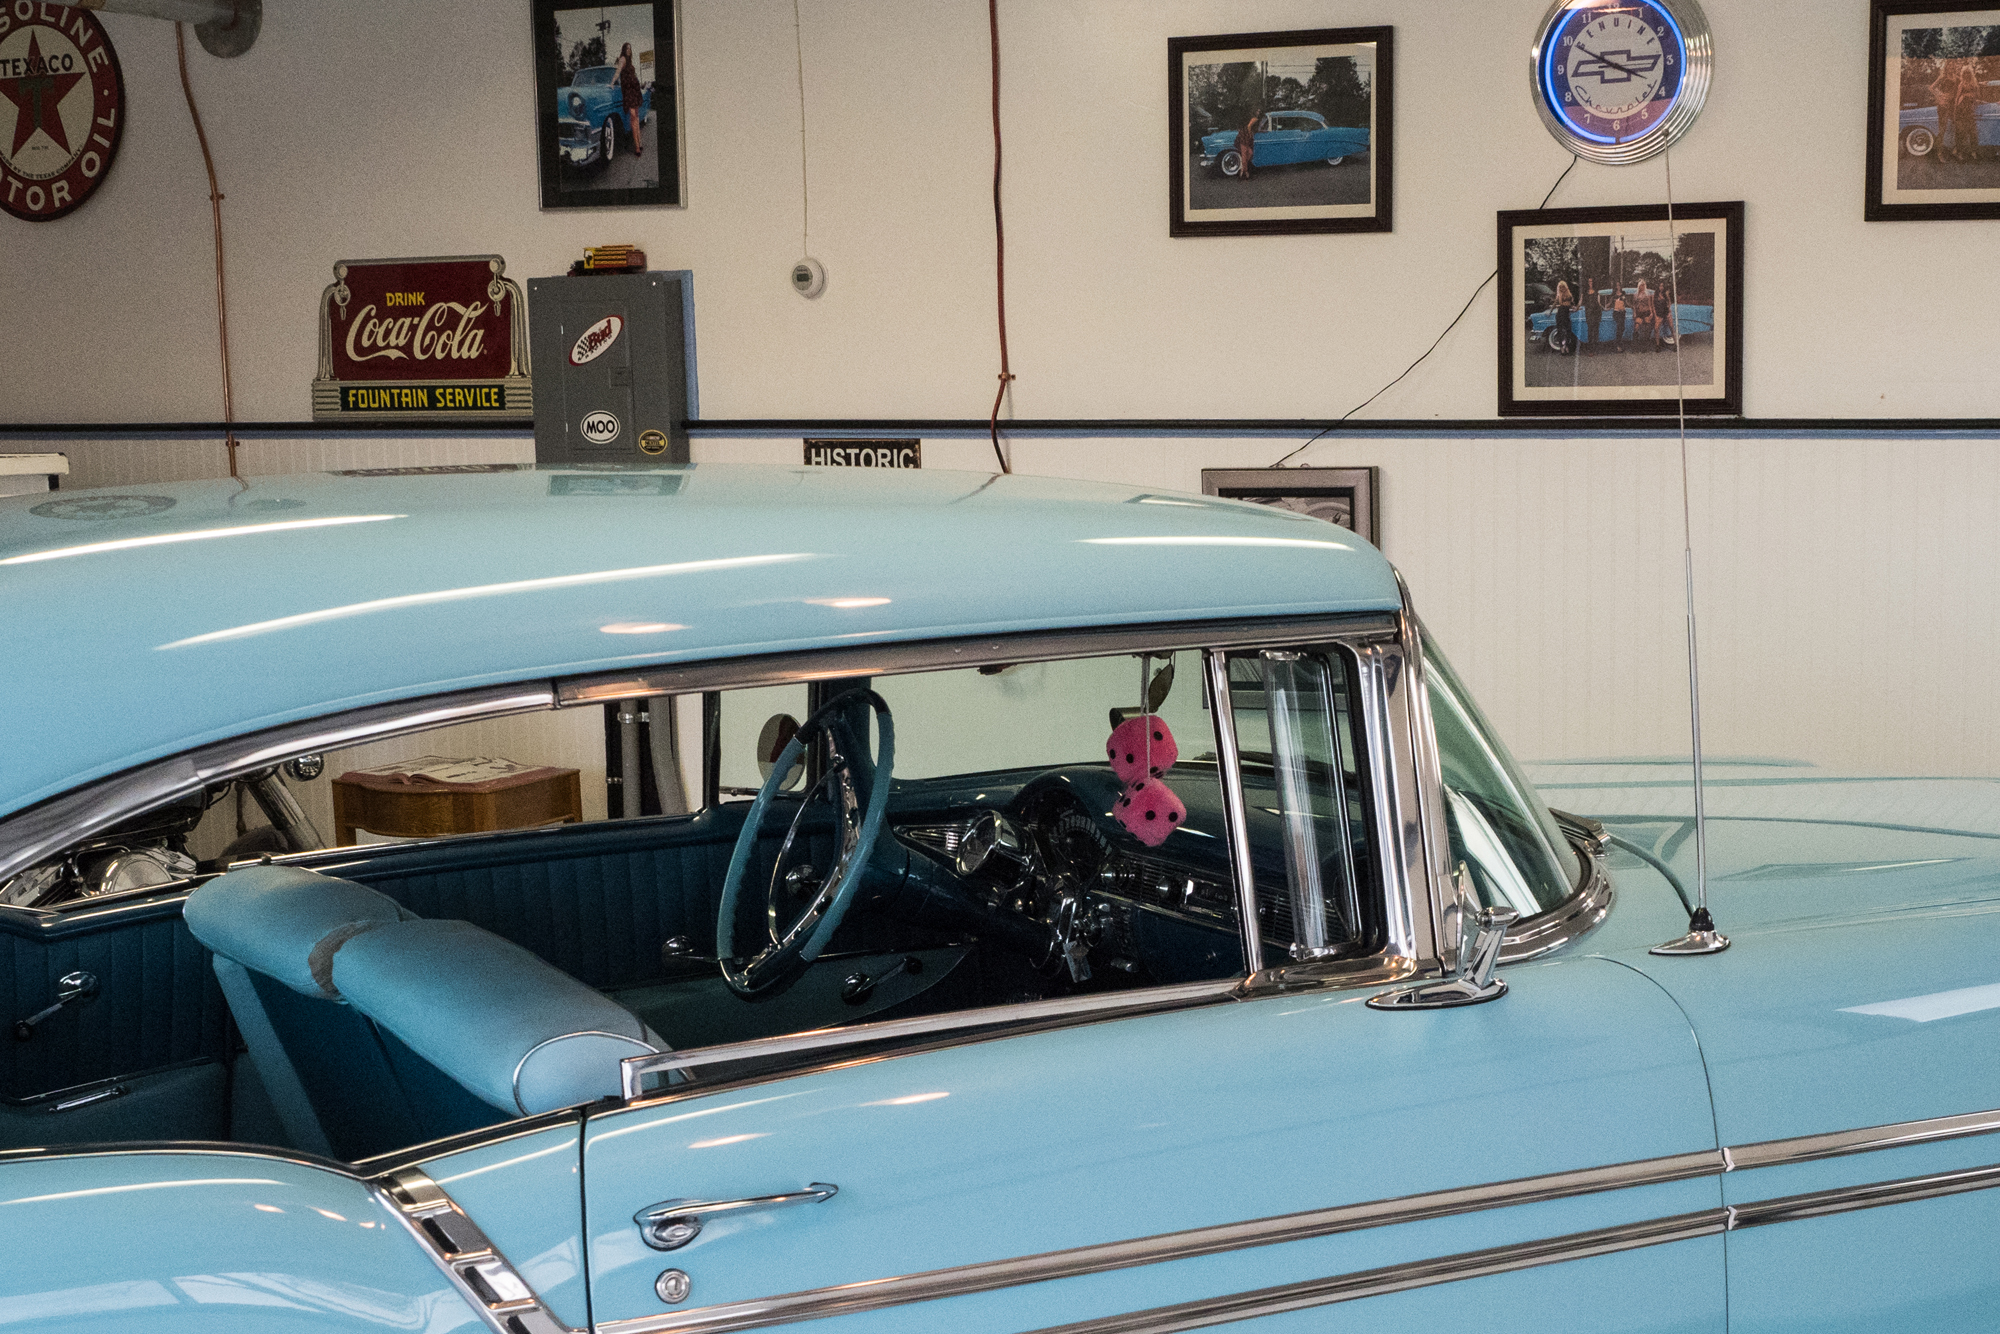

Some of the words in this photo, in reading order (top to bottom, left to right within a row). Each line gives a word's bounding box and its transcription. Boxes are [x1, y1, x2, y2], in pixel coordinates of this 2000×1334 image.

[1582, 12, 1592, 23] 11
[1638, 7, 1643, 18] 1
[1657, 26, 1664, 36] 2
[1563, 36, 1573, 46] 10
[0, 53, 74, 76] TEXACO
[1666, 54, 1674, 65] 3
[1557, 64, 1565, 75] 9
[1565, 92, 1572, 102] 8
[1575, 80, 1658, 114] Chevrolet
[1658, 86, 1666, 97] 4
[1584, 114, 1590, 124] 7
[1641, 109, 1648, 119] 5
[1613, 120, 1620, 130] 6
[81, 108, 115, 178] OIL
[0, 166, 72, 211] TOR
[385, 291, 425, 307] DRINK
[345, 301, 489, 362] Coca-Cola
[349, 388, 429, 408] FOUNTAIN
[435, 388, 500, 408] SERVICE
[586, 420, 615, 434] MOO
[811, 448, 914, 469] HISTORIC
